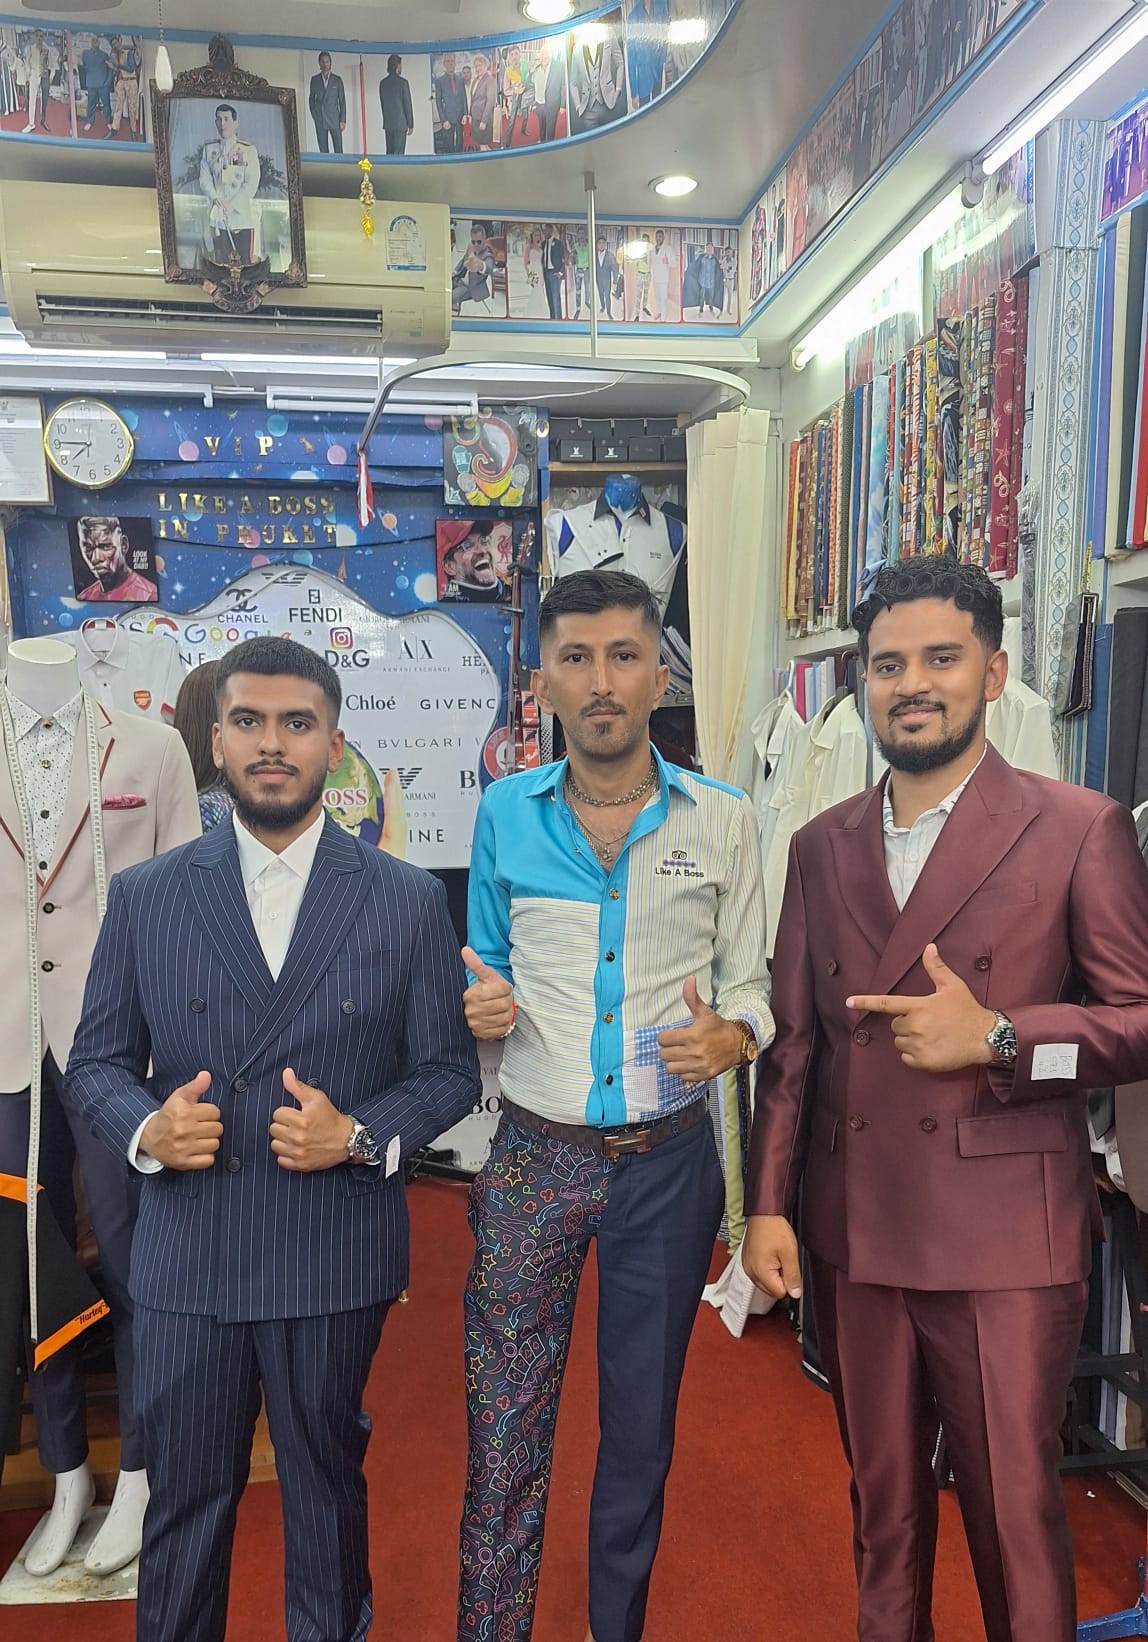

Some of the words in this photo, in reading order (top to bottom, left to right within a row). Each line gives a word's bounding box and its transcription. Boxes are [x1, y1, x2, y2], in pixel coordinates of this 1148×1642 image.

[57, 424, 67, 434] 10
[111, 423, 118, 434] 2
[54, 439, 61, 449] 9
[117, 438, 124, 449] 3
[203, 436, 273, 456] VIP
[61, 455, 68, 465] 8
[114, 454, 120, 464] 4
[73, 465, 80, 476] 7
[89, 469, 97, 480] 6
[104, 465, 111, 476] 5
[157, 492, 227, 514] LIKE
[240, 495, 255, 514] A
[268, 496, 336, 515] BOSS
[158, 519, 189, 539] IN
[215, 524, 336, 544] PHUKET
[449, 584, 459, 592] AM
[217, 614, 269, 623] CHANEL
[289, 608, 342, 623] FENDI
[325, 649, 370, 668] D&G
[345, 694, 396, 711] Chloé
[420, 698, 496, 710] GIVENC
[377, 737, 462, 749] BVLGARI
[404, 792, 436, 801] ARMANI
[655, 867, 671, 876] Like
[675, 868, 681, 877] A
[684, 869, 704, 878] Boss
[79, 1303, 103, 1325] Hurley
